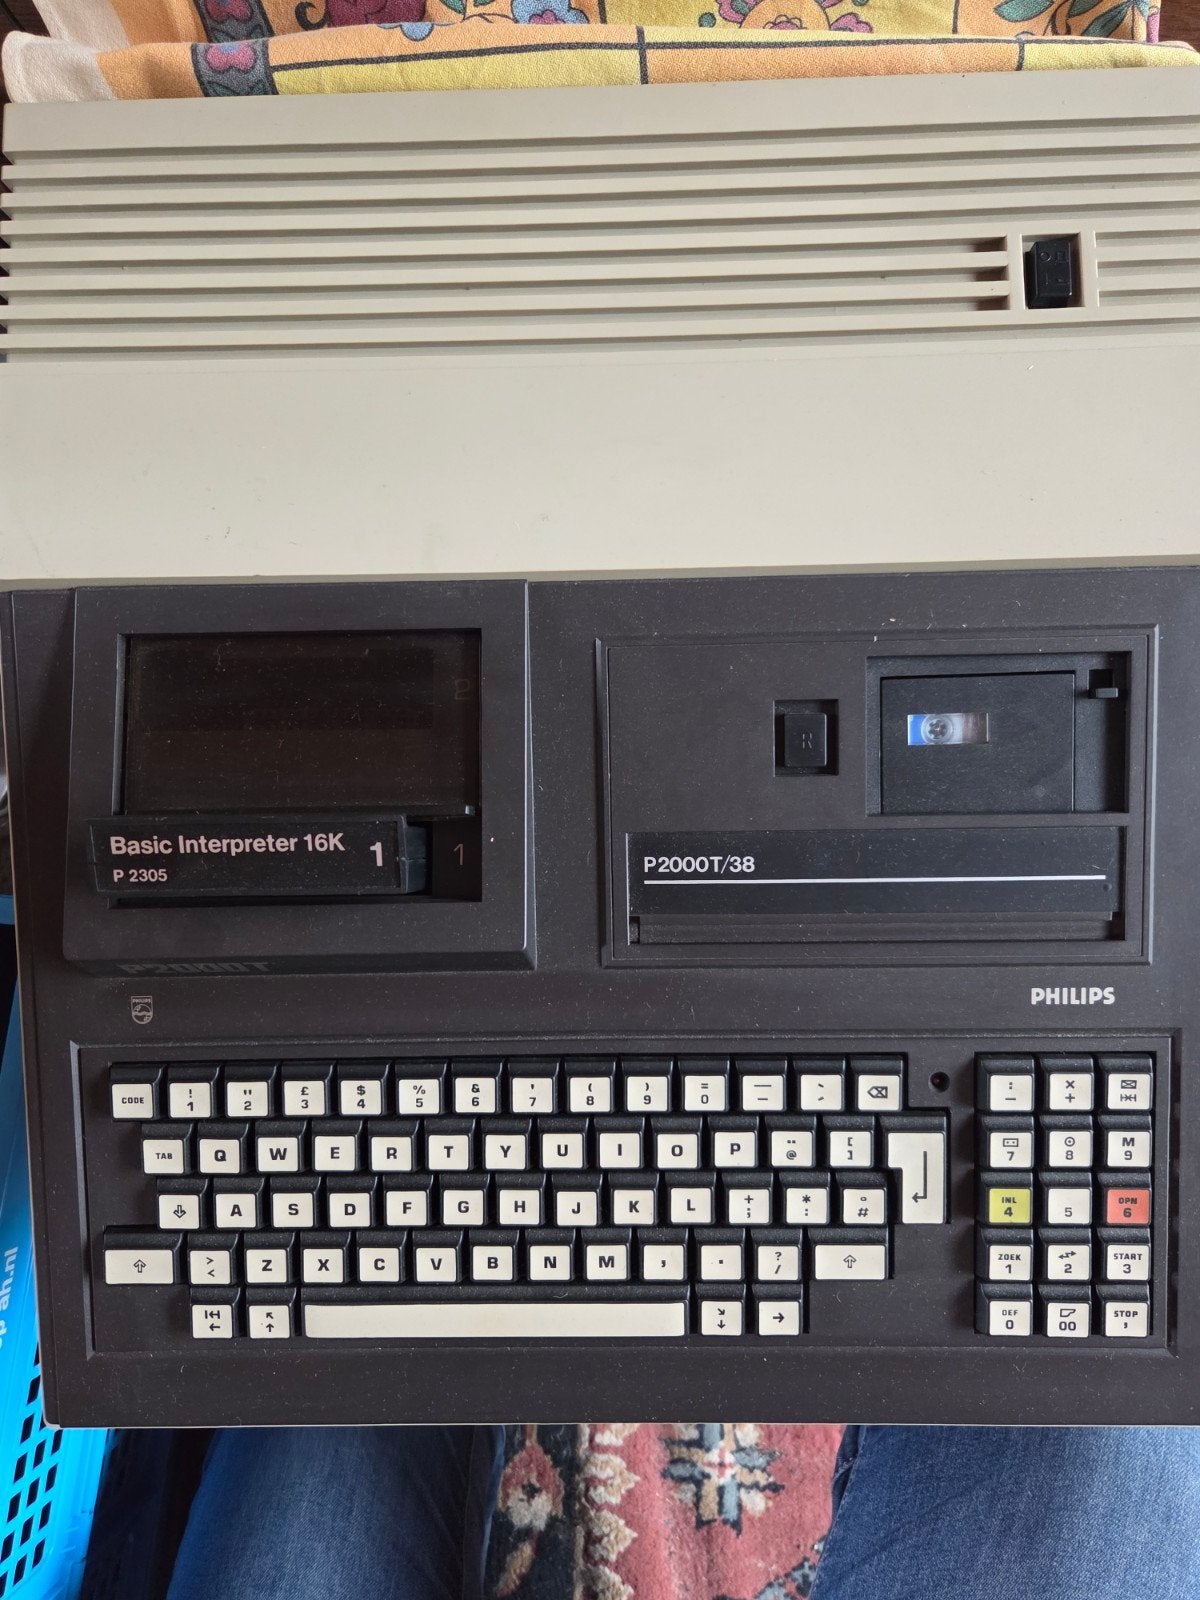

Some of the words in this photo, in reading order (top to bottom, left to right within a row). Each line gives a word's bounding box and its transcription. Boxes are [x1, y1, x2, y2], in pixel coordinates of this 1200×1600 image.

[109, 835, 173, 856] Basic
[177, 834, 299, 857] Interpreter
[303, 832, 346, 852] 16K
[369, 841, 384, 867] 1
[453, 843, 464, 866] 1
[644, 854, 755, 874] P2000T/38
[113, 869, 125, 883] P
[128, 868, 168, 883] 2305
[1031, 986, 1117, 1006] PHILIPS
[121, 1096, 145, 1105] CODE
[214, 1149, 227, 1162] Q
[269, 1147, 288, 1161] W
[330, 1146, 340, 1160] E
[386, 1146, 398, 1160] R
[443, 1145, 454, 1159] T
[499, 1145, 512, 1158] Y
[557, 1144, 569, 1157] U
[671, 1144, 684, 1157] O
[730, 1142, 741, 1156] P
[155, 1152, 173, 1160] TAB
[230, 1204, 243, 1217] A
[288, 1203, 299, 1216] S
[344, 1203, 357, 1216] D
[402, 1201, 412, 1215] F
[457, 1200, 470, 1214] G
[514, 1200, 526, 1213] H
[571, 1201, 581, 1215] J
[628, 1200, 640, 1213] K
[686, 1198, 696, 1212] L
[487, 1256, 499, 1270] B
[543, 1256, 557, 1269] N
[598, 1255, 615, 1269] M
[998, 1253, 1021, 1261] ZOEK
[1113, 1253, 1143, 1261] START
[261, 1259, 273, 1272] Z
[317, 1258, 330, 1272] X
[373, 1258, 386, 1271] C
[430, 1258, 443, 1271] V
[0, 1246, 19, 1311] ah.nl
[1113, 1310, 1139, 1318] STOP
[1058, 1321, 1077, 1332] 00
